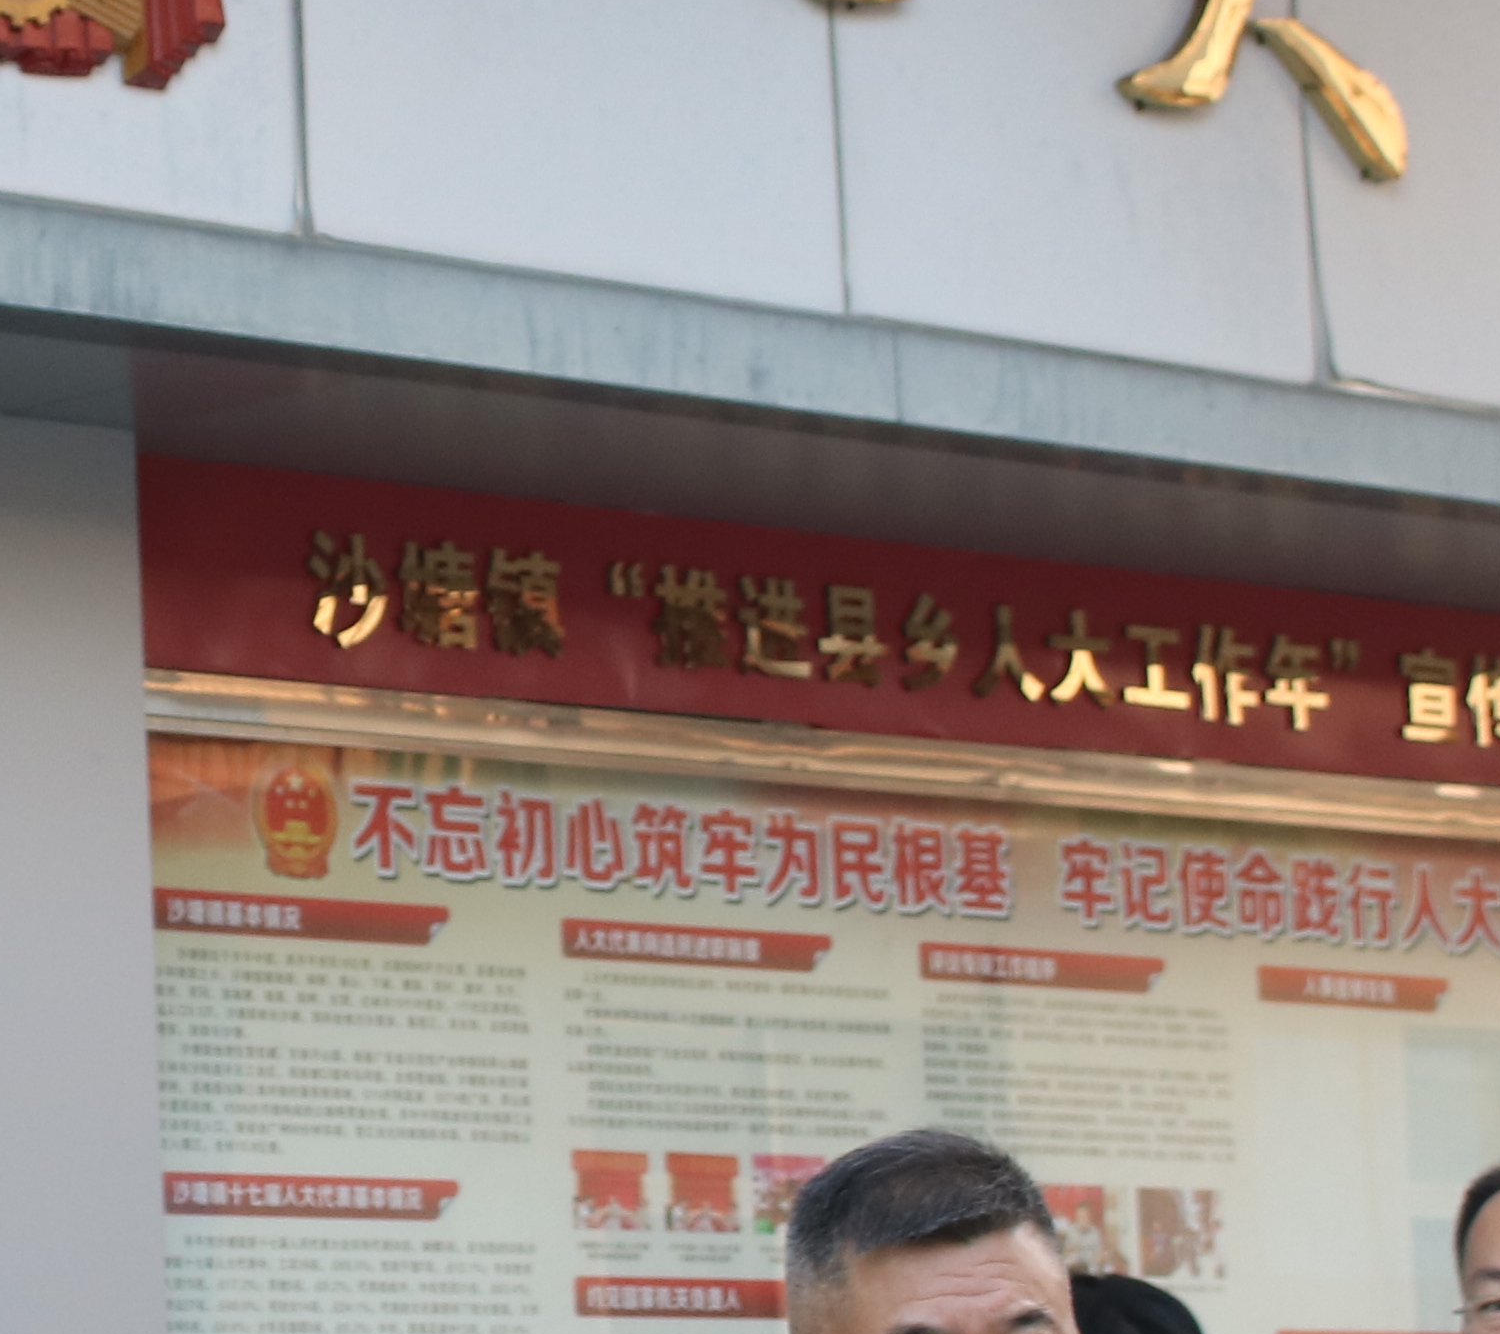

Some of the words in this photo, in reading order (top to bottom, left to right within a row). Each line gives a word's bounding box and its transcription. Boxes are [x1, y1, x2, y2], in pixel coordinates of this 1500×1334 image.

[350, 780, 1013, 918] 不忘初心筑牢为民根基
